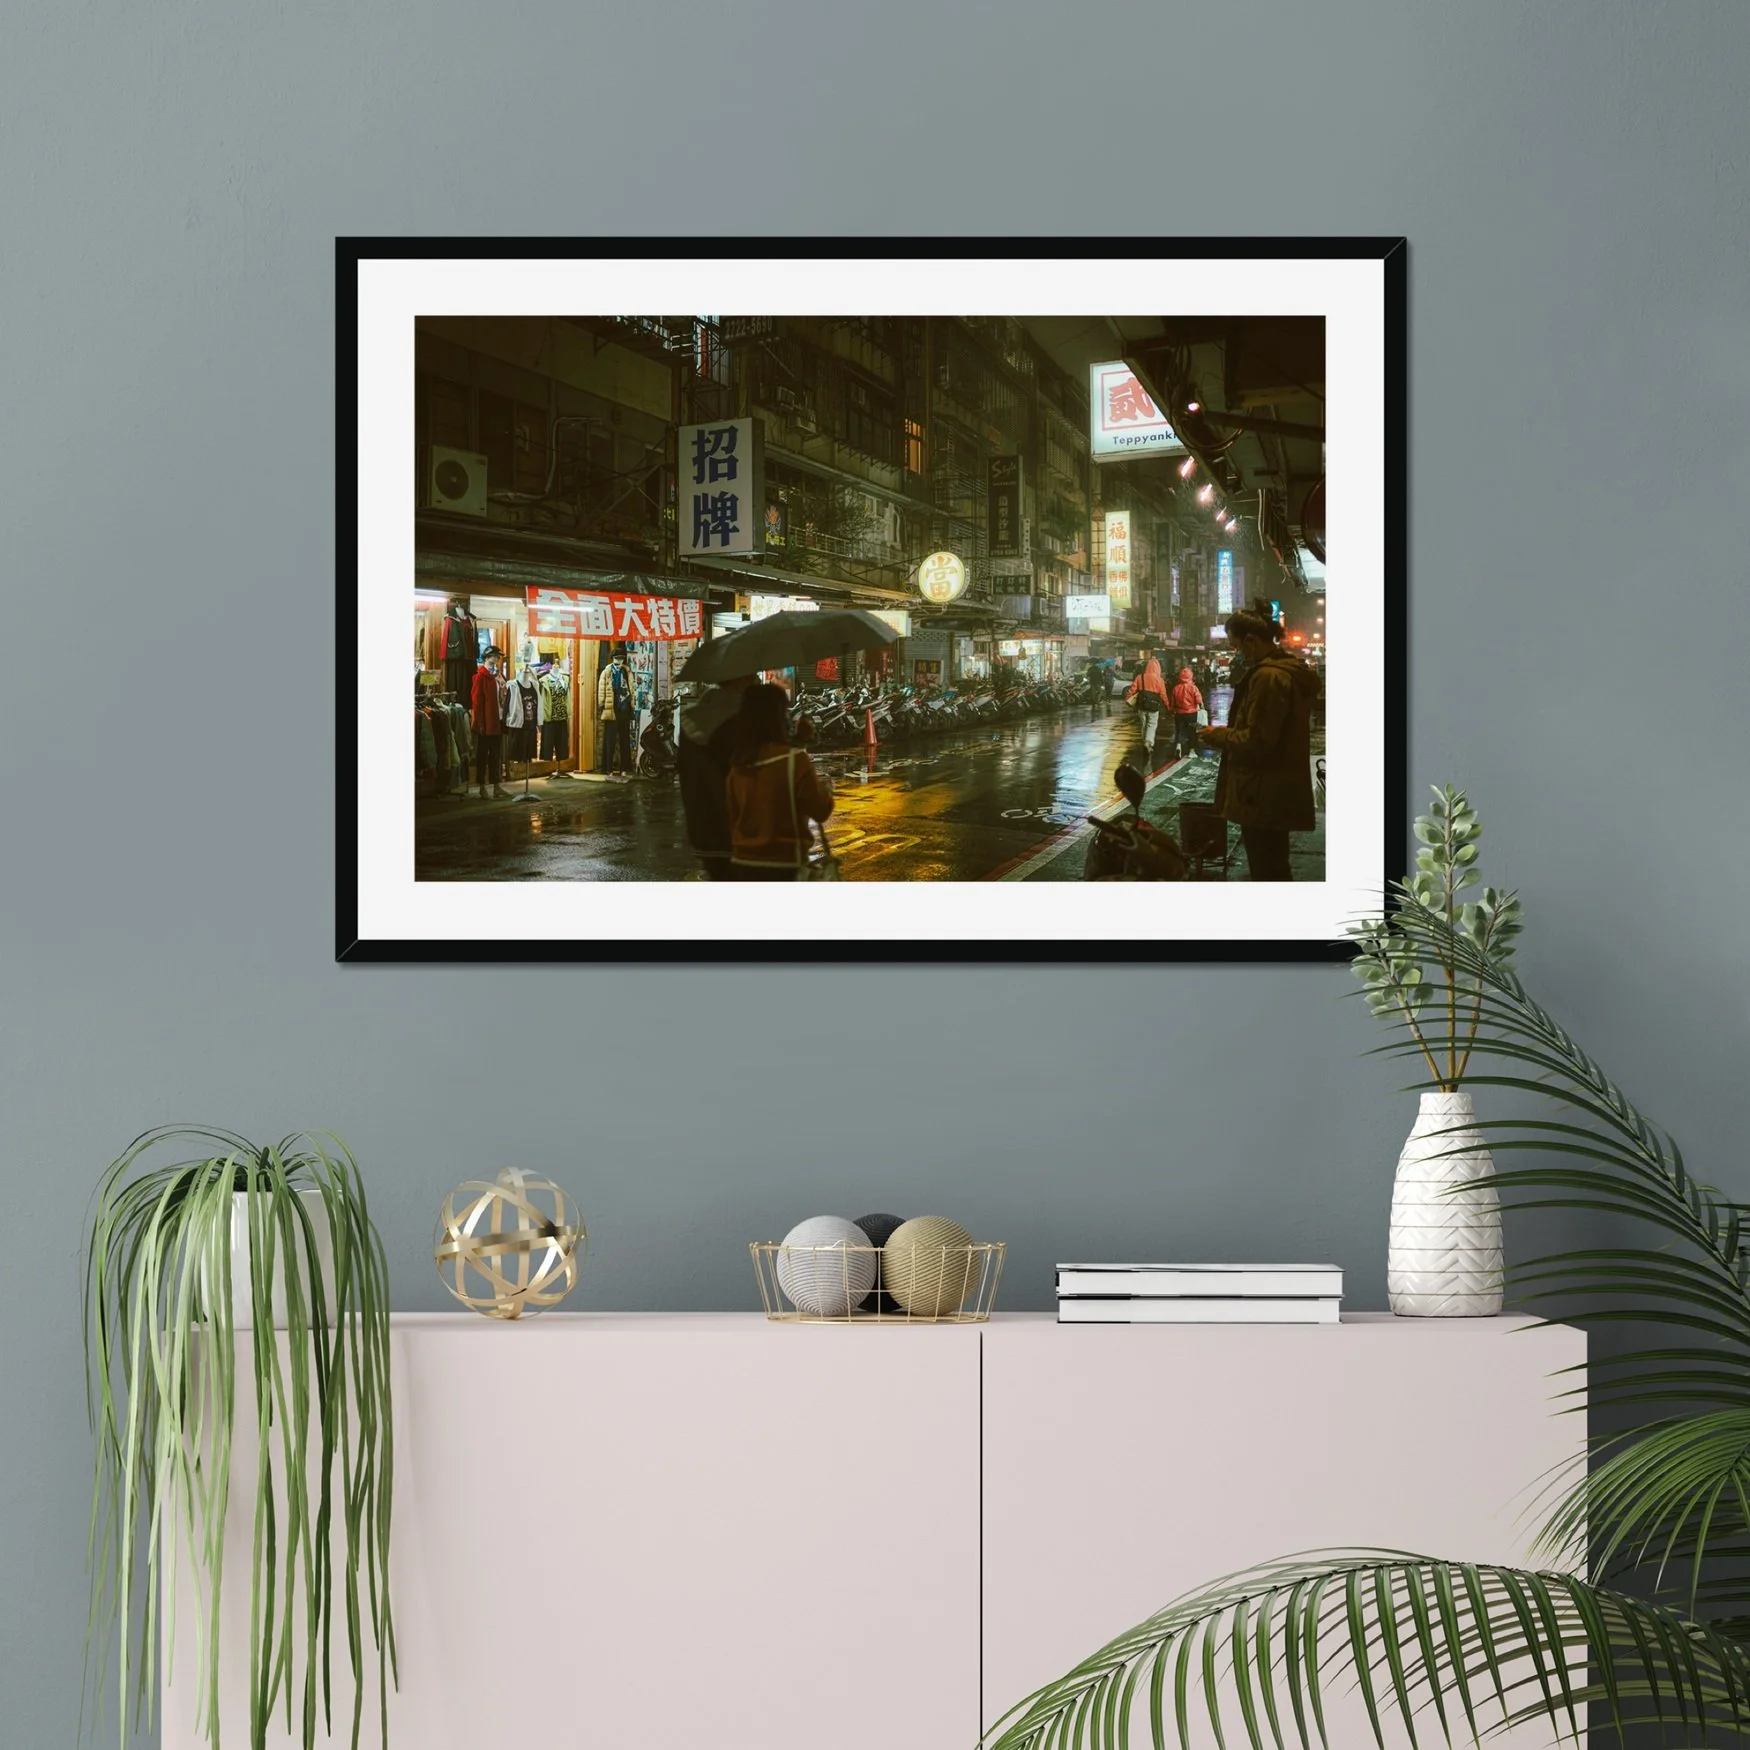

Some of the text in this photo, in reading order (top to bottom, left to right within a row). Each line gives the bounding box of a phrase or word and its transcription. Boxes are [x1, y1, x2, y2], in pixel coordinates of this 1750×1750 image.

[691, 425, 740, 549] 招牌
[1108, 521, 1128, 565] 福順
[926, 555, 957, 599] 當
[536, 588, 700, 637] 全面大特價
